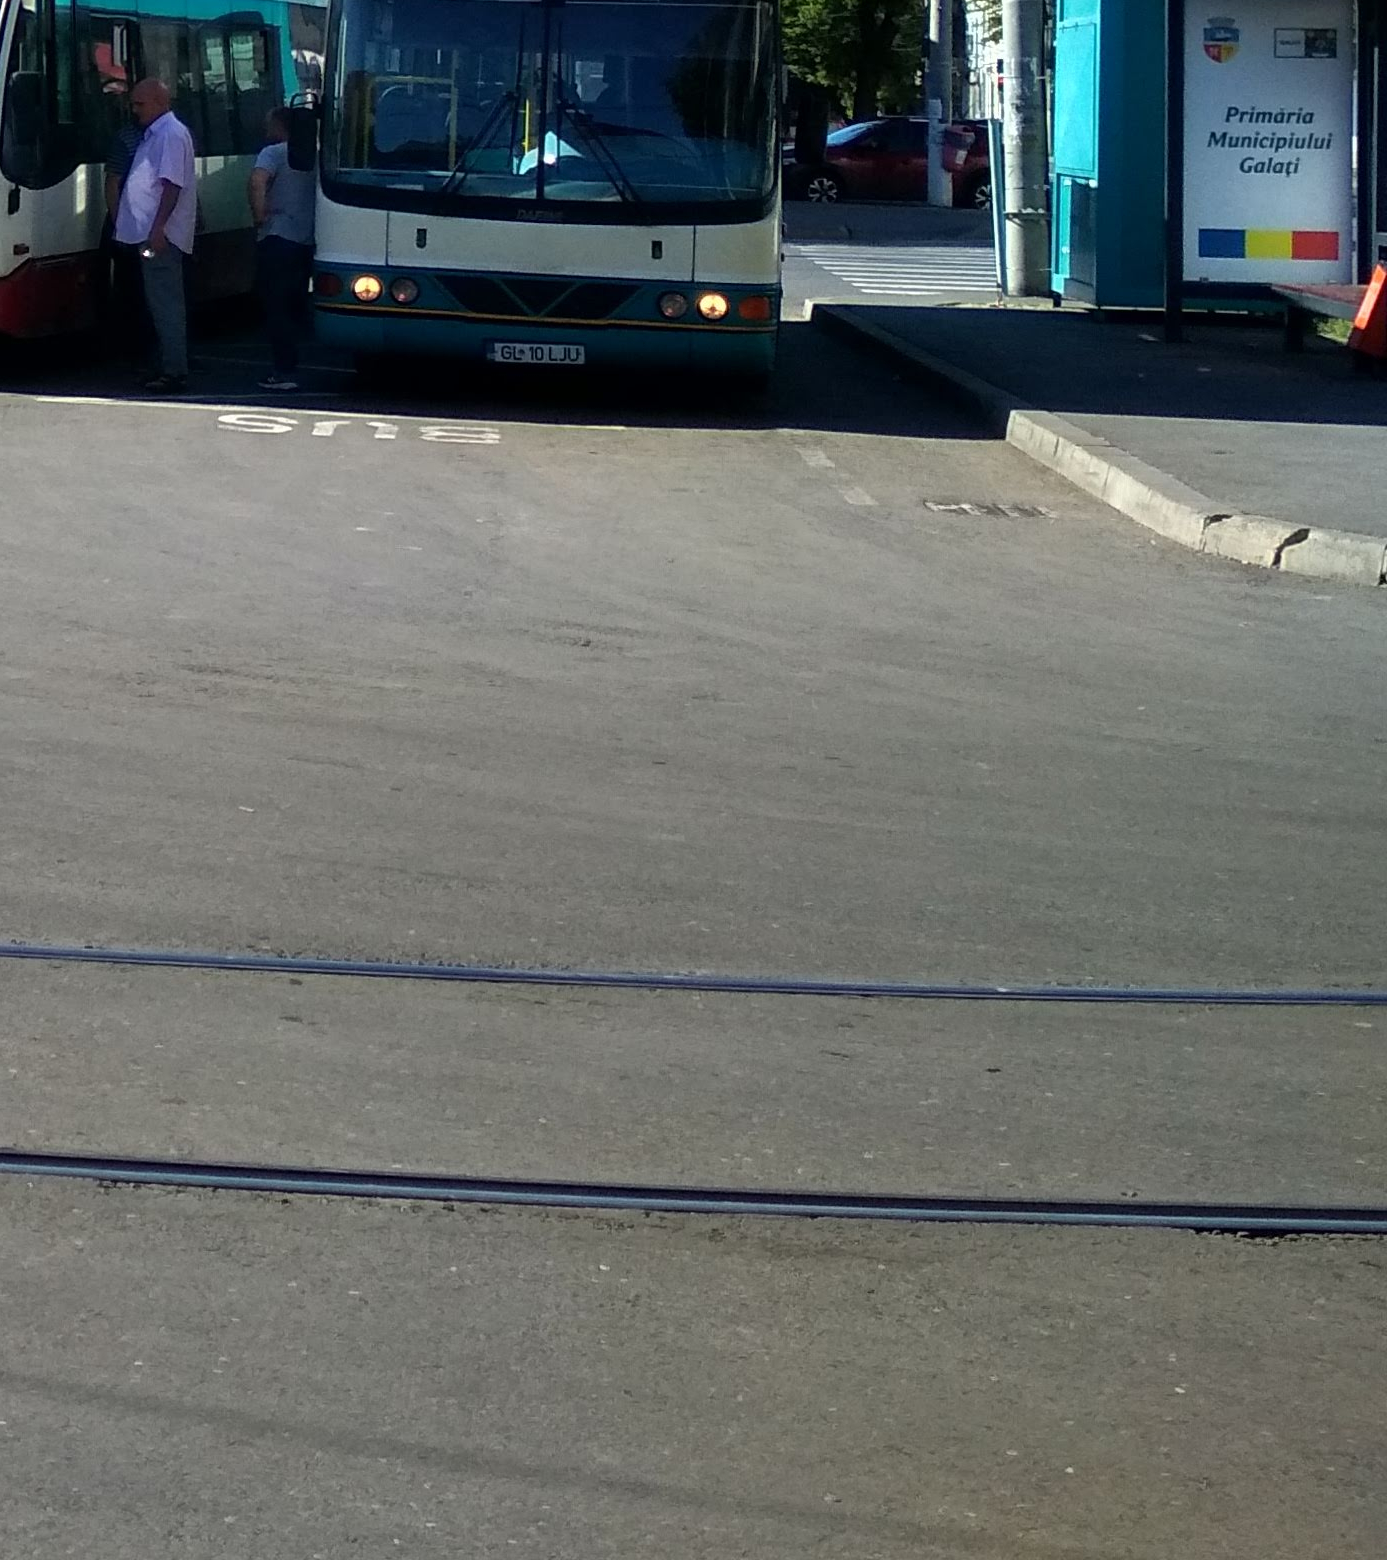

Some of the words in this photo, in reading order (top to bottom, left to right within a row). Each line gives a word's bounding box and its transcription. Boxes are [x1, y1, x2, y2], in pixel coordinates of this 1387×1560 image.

[1207, 131, 1333, 153] Municipiului
[1239, 156, 1300, 177] Galați
[501, 346, 522, 360] GL
[529, 346, 544, 361] 10
